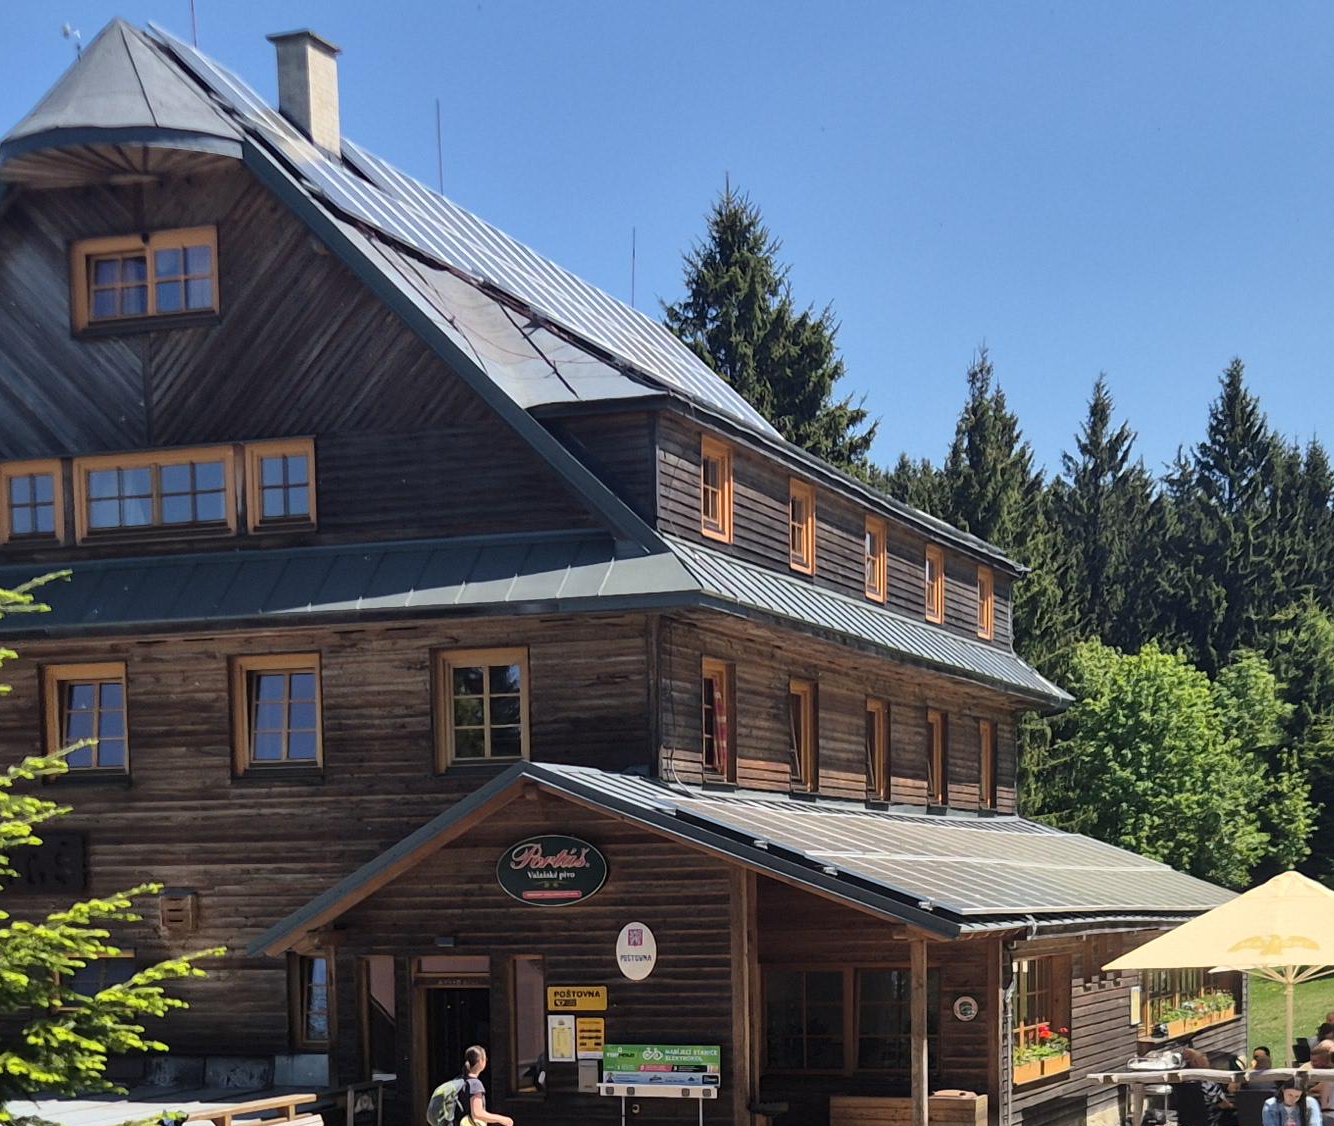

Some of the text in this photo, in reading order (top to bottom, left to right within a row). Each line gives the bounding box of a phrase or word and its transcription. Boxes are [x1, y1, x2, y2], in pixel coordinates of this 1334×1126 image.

[510, 843, 589, 869] Portáš
[559, 871, 576, 880] pivo
[553, 989, 601, 998] POŠTOVNA
